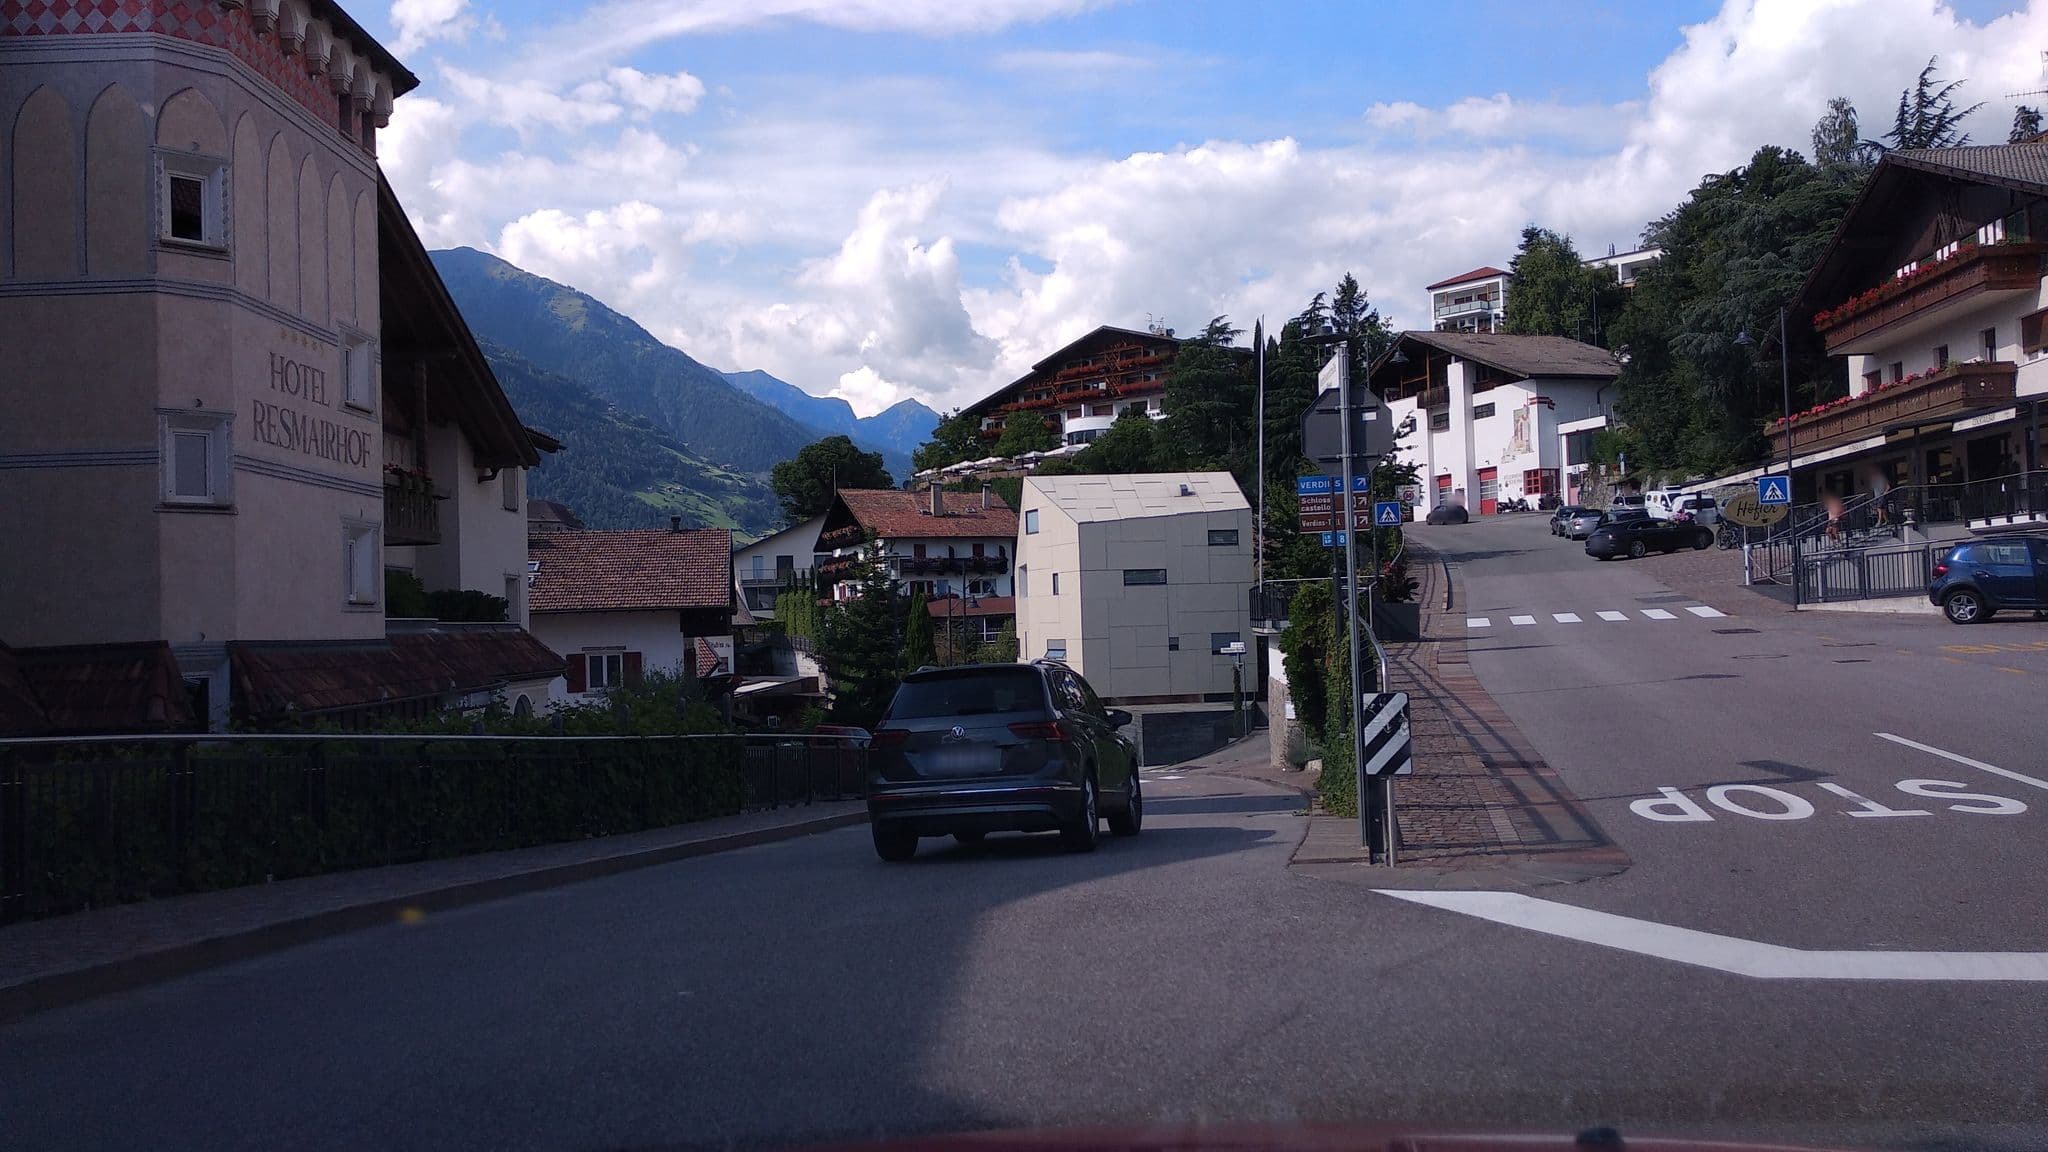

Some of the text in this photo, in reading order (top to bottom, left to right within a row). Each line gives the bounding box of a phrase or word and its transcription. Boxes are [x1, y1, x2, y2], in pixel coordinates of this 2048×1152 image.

[269, 352, 330, 408] HOTEL
[253, 400, 371, 468] RESMAIRHOF
[1300, 480, 1341, 489] VERDIS
[1629, 779, 2028, 822] STOP
